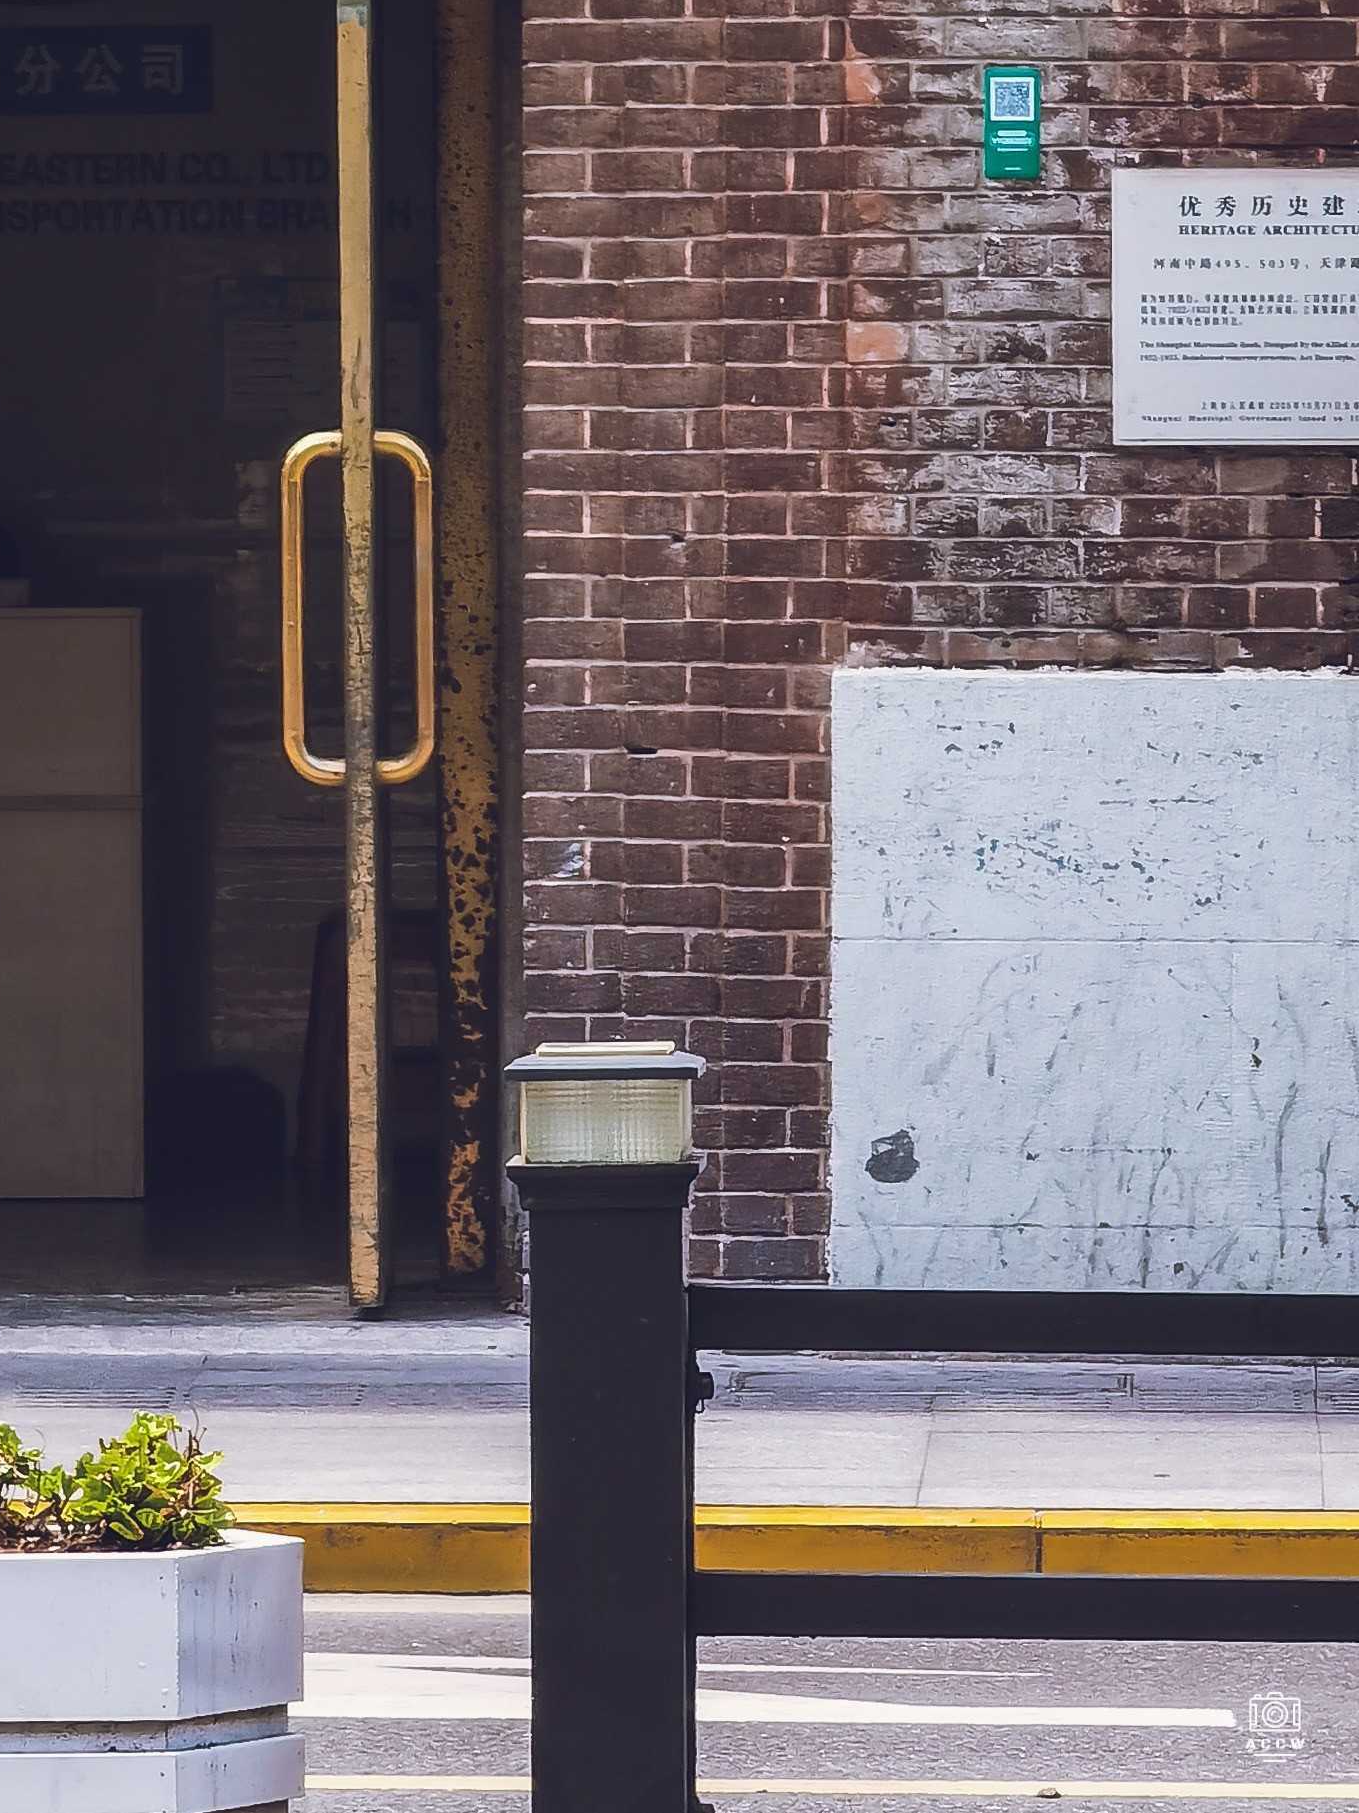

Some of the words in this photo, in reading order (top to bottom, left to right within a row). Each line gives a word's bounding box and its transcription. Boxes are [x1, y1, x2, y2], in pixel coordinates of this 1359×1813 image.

[1179, 195, 1359, 217] 优秀历史建
[1178, 225, 1256, 236] HERITAGE
